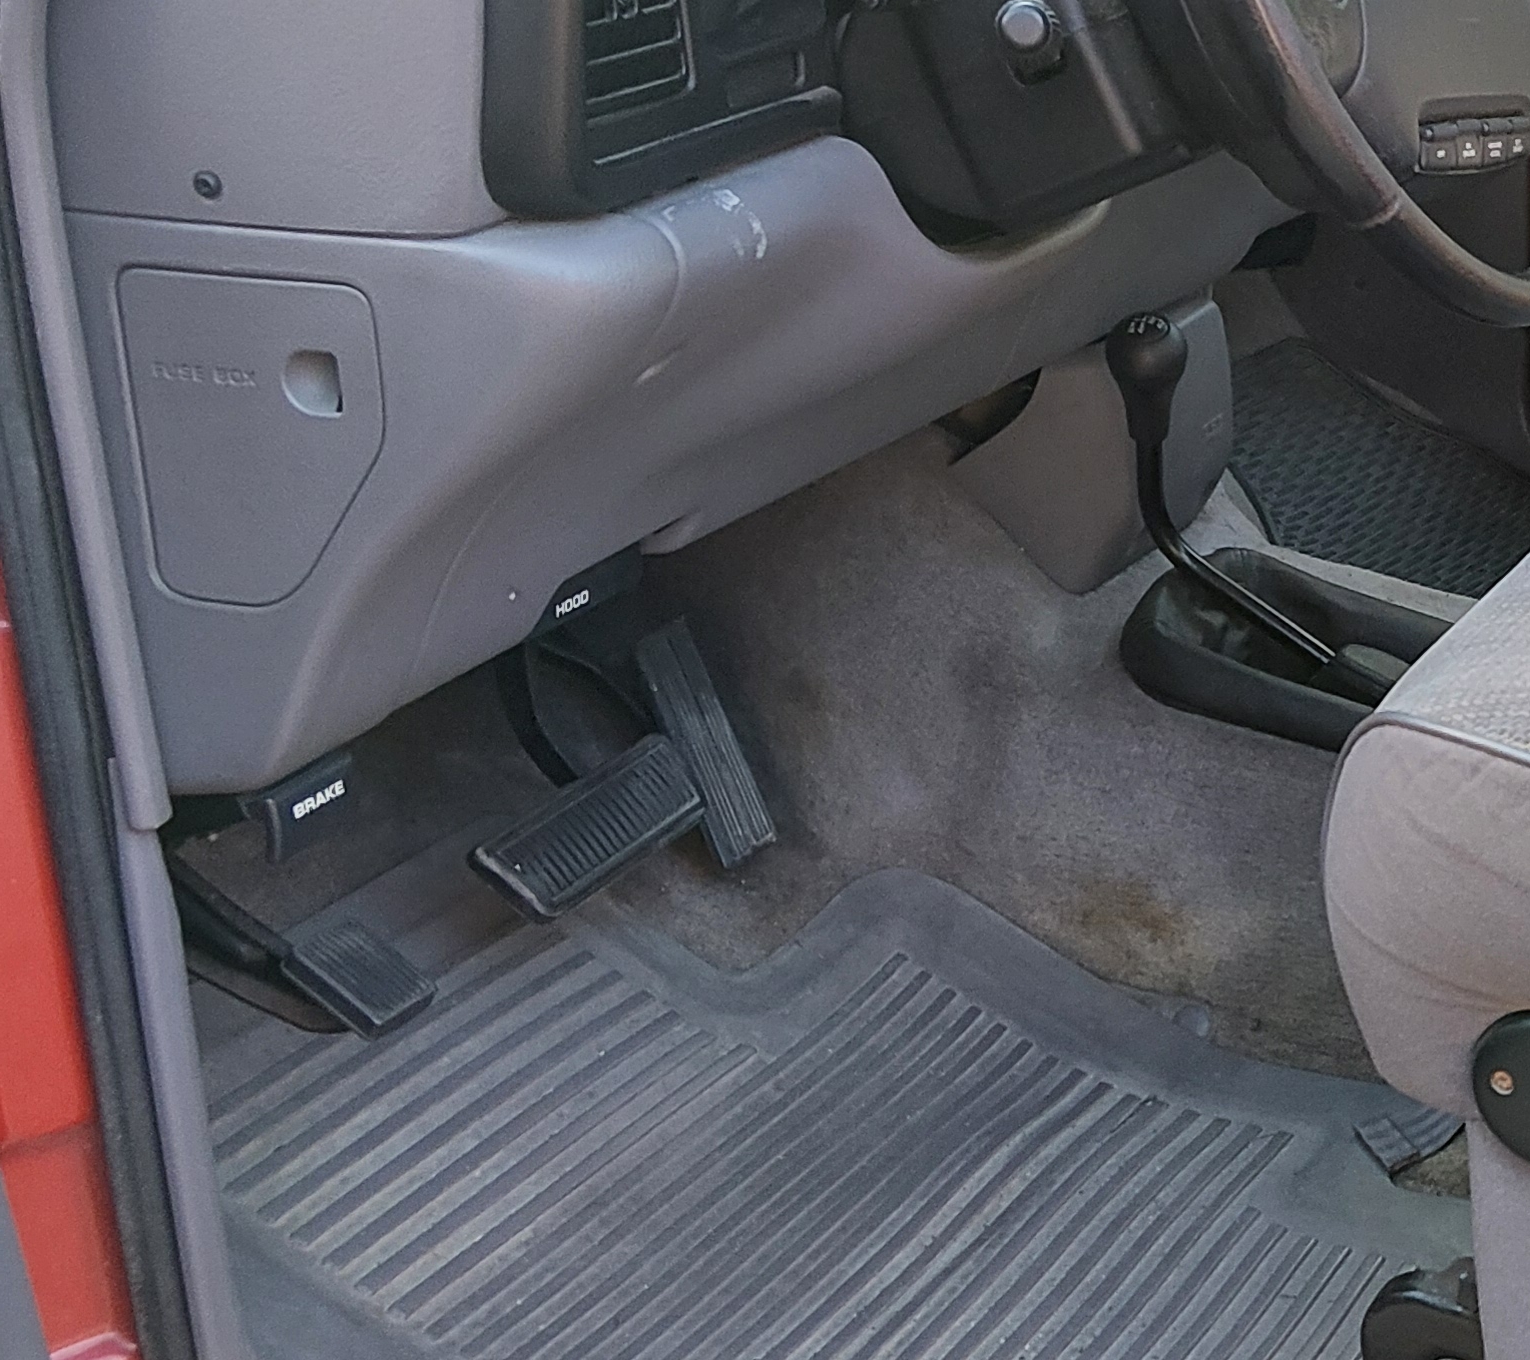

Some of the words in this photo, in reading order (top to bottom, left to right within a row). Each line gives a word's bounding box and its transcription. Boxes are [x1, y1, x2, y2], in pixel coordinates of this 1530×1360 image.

[152, 360, 203, 383] FUSE
[213, 365, 257, 388] BOX
[555, 588, 590, 619] HOOD
[292, 779, 346, 820] BRAKE
